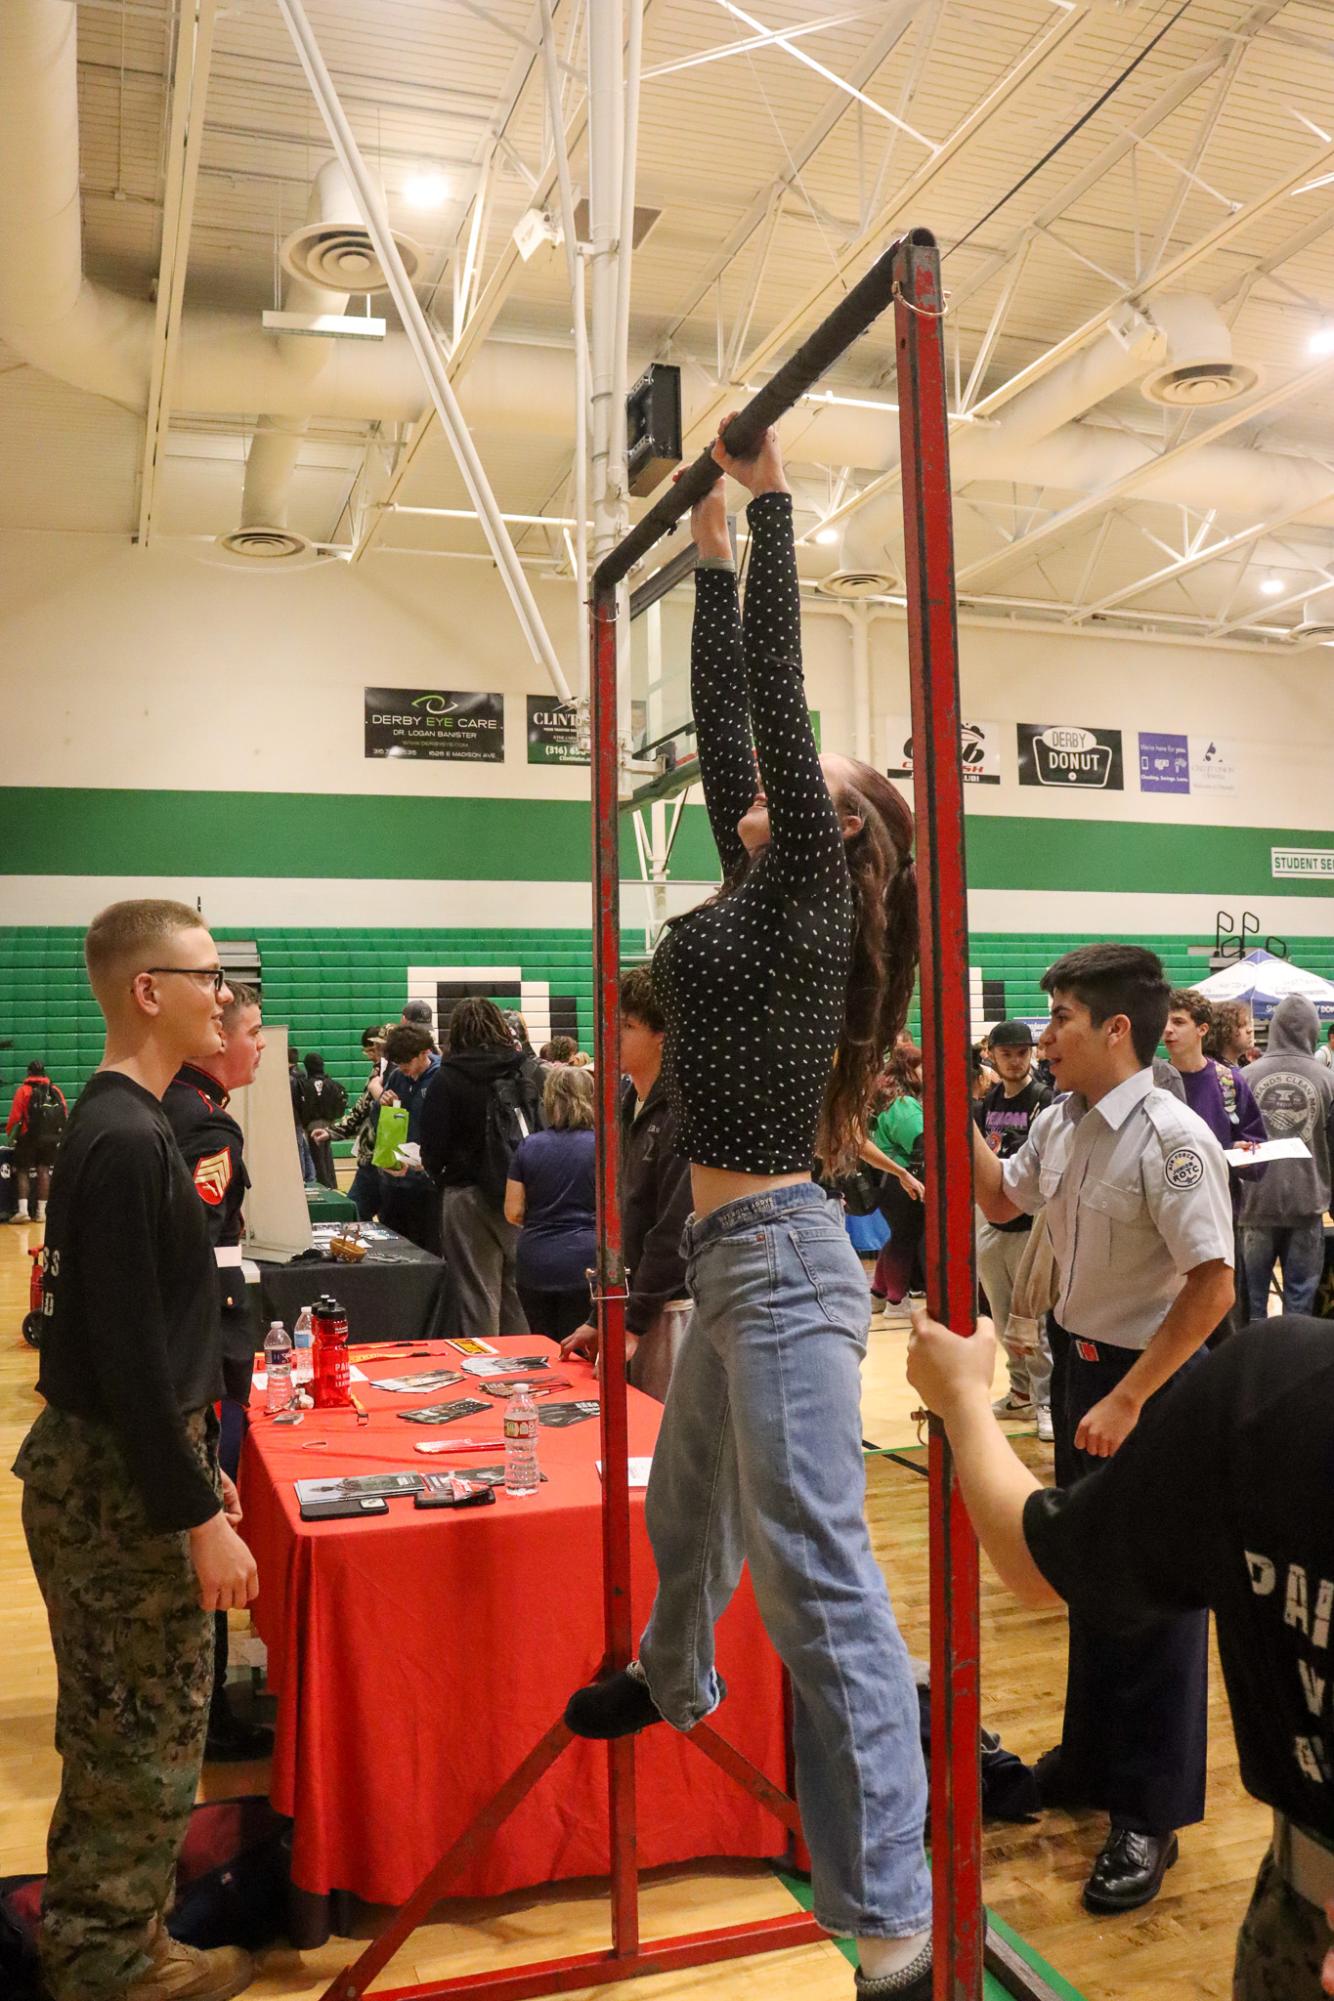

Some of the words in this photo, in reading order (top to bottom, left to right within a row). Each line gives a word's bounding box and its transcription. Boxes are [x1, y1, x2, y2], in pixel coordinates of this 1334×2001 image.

[372, 714, 422, 726] DERBY
[426, 717, 453, 727] EYE
[457, 718, 497, 729] CARE
[437, 731, 477, 739] BANISTER
[1052, 730, 1087, 749] DERBY
[1049, 751, 1100, 772] DONUT
[1274, 856, 1318, 870] STUDENT
[1320, 858, 1334, 871] SE
[1173, 1165, 1200, 1182] ROTC
[1244, 1550, 1334, 1649] PAI
